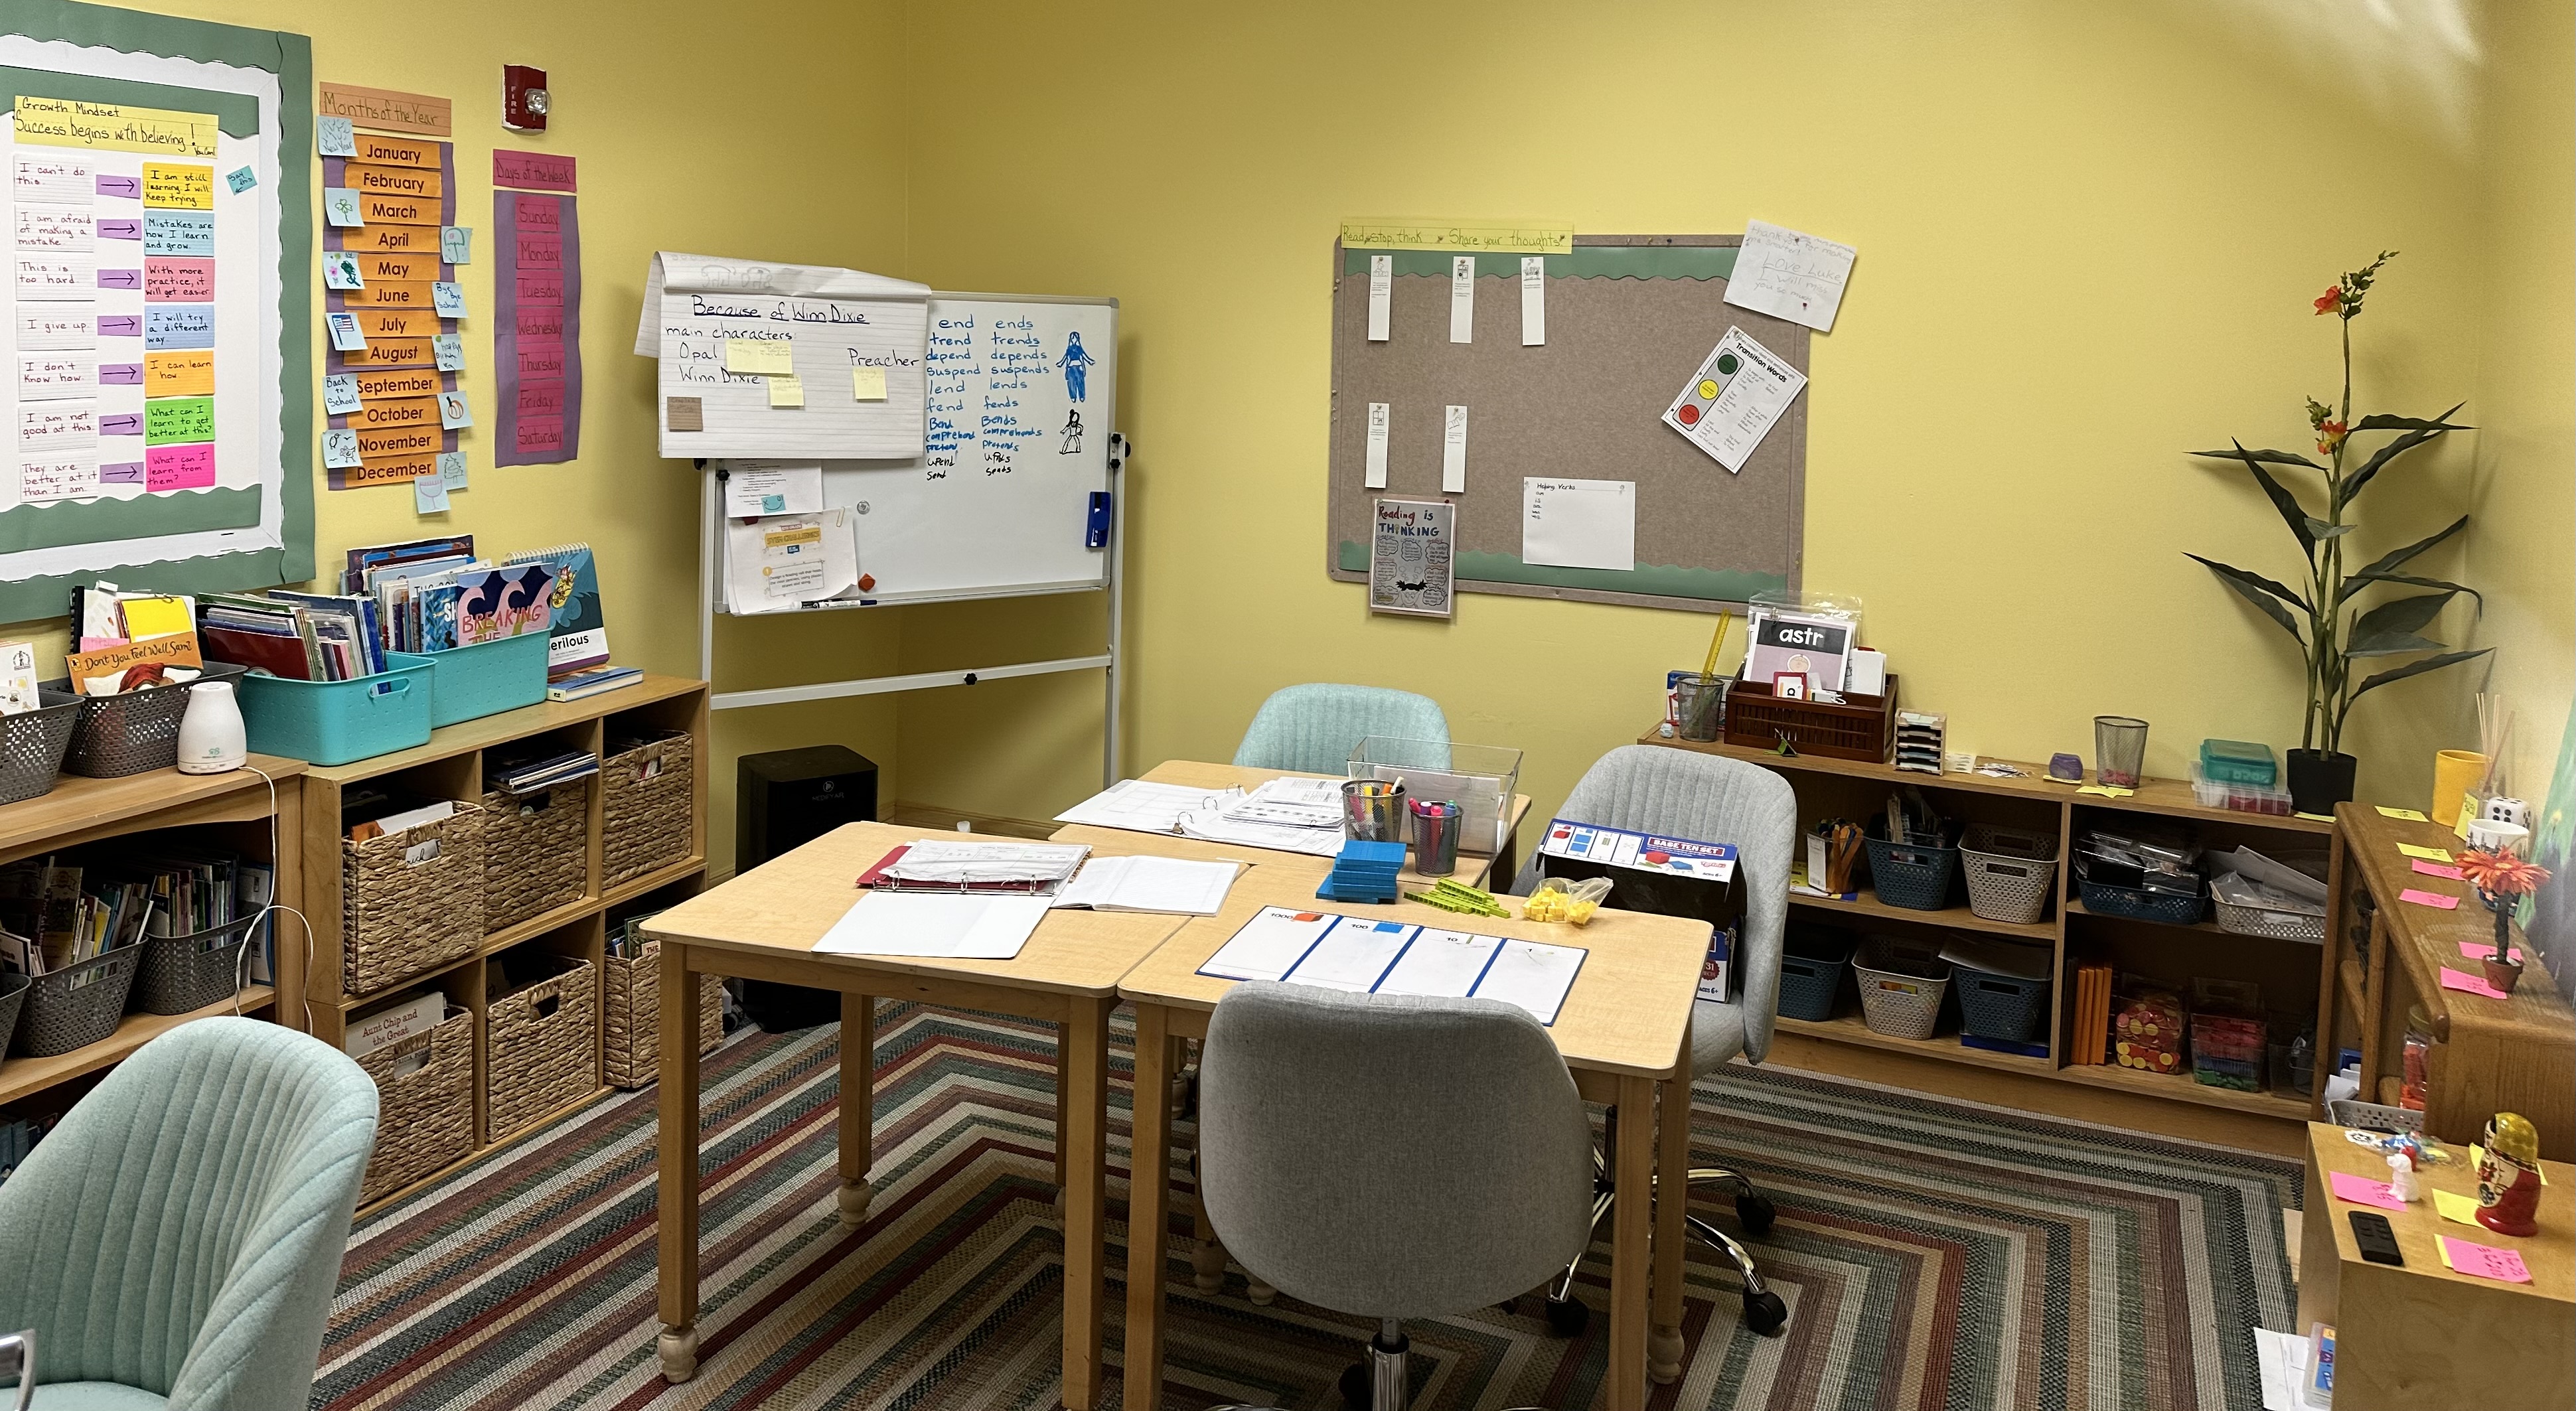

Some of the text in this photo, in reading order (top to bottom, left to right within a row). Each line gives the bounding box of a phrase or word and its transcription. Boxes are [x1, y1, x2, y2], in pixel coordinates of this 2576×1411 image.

[23, 97, 119, 117] Growth Mindset
[324, 92, 437, 125] Months of the Year
[15, 110, 66, 135] Success
[71, 116, 109, 144] begins
[115, 124, 137, 141] with
[366, 144, 421, 164] January
[19, 163, 85, 176] I can't do
[496, 158, 519, 185] Days
[523, 161, 530, 179] of
[363, 173, 424, 192] February
[21, 212, 28, 221] I
[61, 214, 91, 224] afraid
[372, 205, 417, 218] March
[520, 204, 559, 226] Sunday
[20, 224, 30, 234] of
[169, 230, 176, 239] I
[378, 233, 408, 248] April
[1397, 228, 1422, 243] think
[1449, 228, 1479, 247] Share
[1484, 236, 1503, 250] your
[521, 242, 559, 269] Monday
[21, 262, 47, 272] This
[378, 262, 409, 277] May
[436, 283, 451, 294] Bye
[516, 278, 561, 304] Tuesday
[1754, 282, 1772, 291] you
[1806, 282, 1827, 293] miss
[376, 289, 409, 301] June
[692, 295, 867, 324] Because of Winn Dixie
[27, 319, 37, 329] I
[46, 323, 66, 333] give
[379, 317, 406, 333] July
[517, 317, 562, 340] Wednesday
[939, 314, 1033, 329] end ends
[666, 327, 702, 337] main
[930, 332, 1040, 346] trend trends
[370, 346, 417, 362] August
[679, 342, 717, 363] Opal
[847, 348, 920, 367] Preacher
[926, 348, 1047, 365] depend depends
[518, 354, 562, 372] Thursday
[1736, 342, 1766, 368] Transition
[1767, 365, 1787, 382] Words
[679, 366, 760, 385] Winn Dixie
[927, 362, 1049, 380] suspend suspends
[327, 377, 348, 388] Back
[356, 378, 433, 394] September
[929, 378, 1027, 394] lend lends
[328, 397, 356, 407] School
[520, 390, 554, 410] Friday
[927, 396, 1019, 413] fend fends
[367, 407, 423, 422] October
[929, 415, 1017, 429] Bend Bends
[358, 435, 431, 451] November
[518, 427, 562, 445] Saturday
[22, 463, 45, 474] They
[357, 463, 431, 480] December
[25, 471, 97, 485] better at it
[23, 486, 47, 496] than
[53, 486, 61, 494] I
[1379, 506, 1433, 526] Reading is
[463, 605, 542, 633] BREAKING
[549, 636, 589, 650] erilous
[1779, 626, 1824, 646] astr
[85, 655, 110, 671] Don't
[112, 654, 131, 668] You
[130, 646, 147, 659] Feel
[1654, 839, 1680, 848] BASE
[362, 1009, 417, 1037] Aunt Chip and
[372, 1025, 410, 1046] the Great
